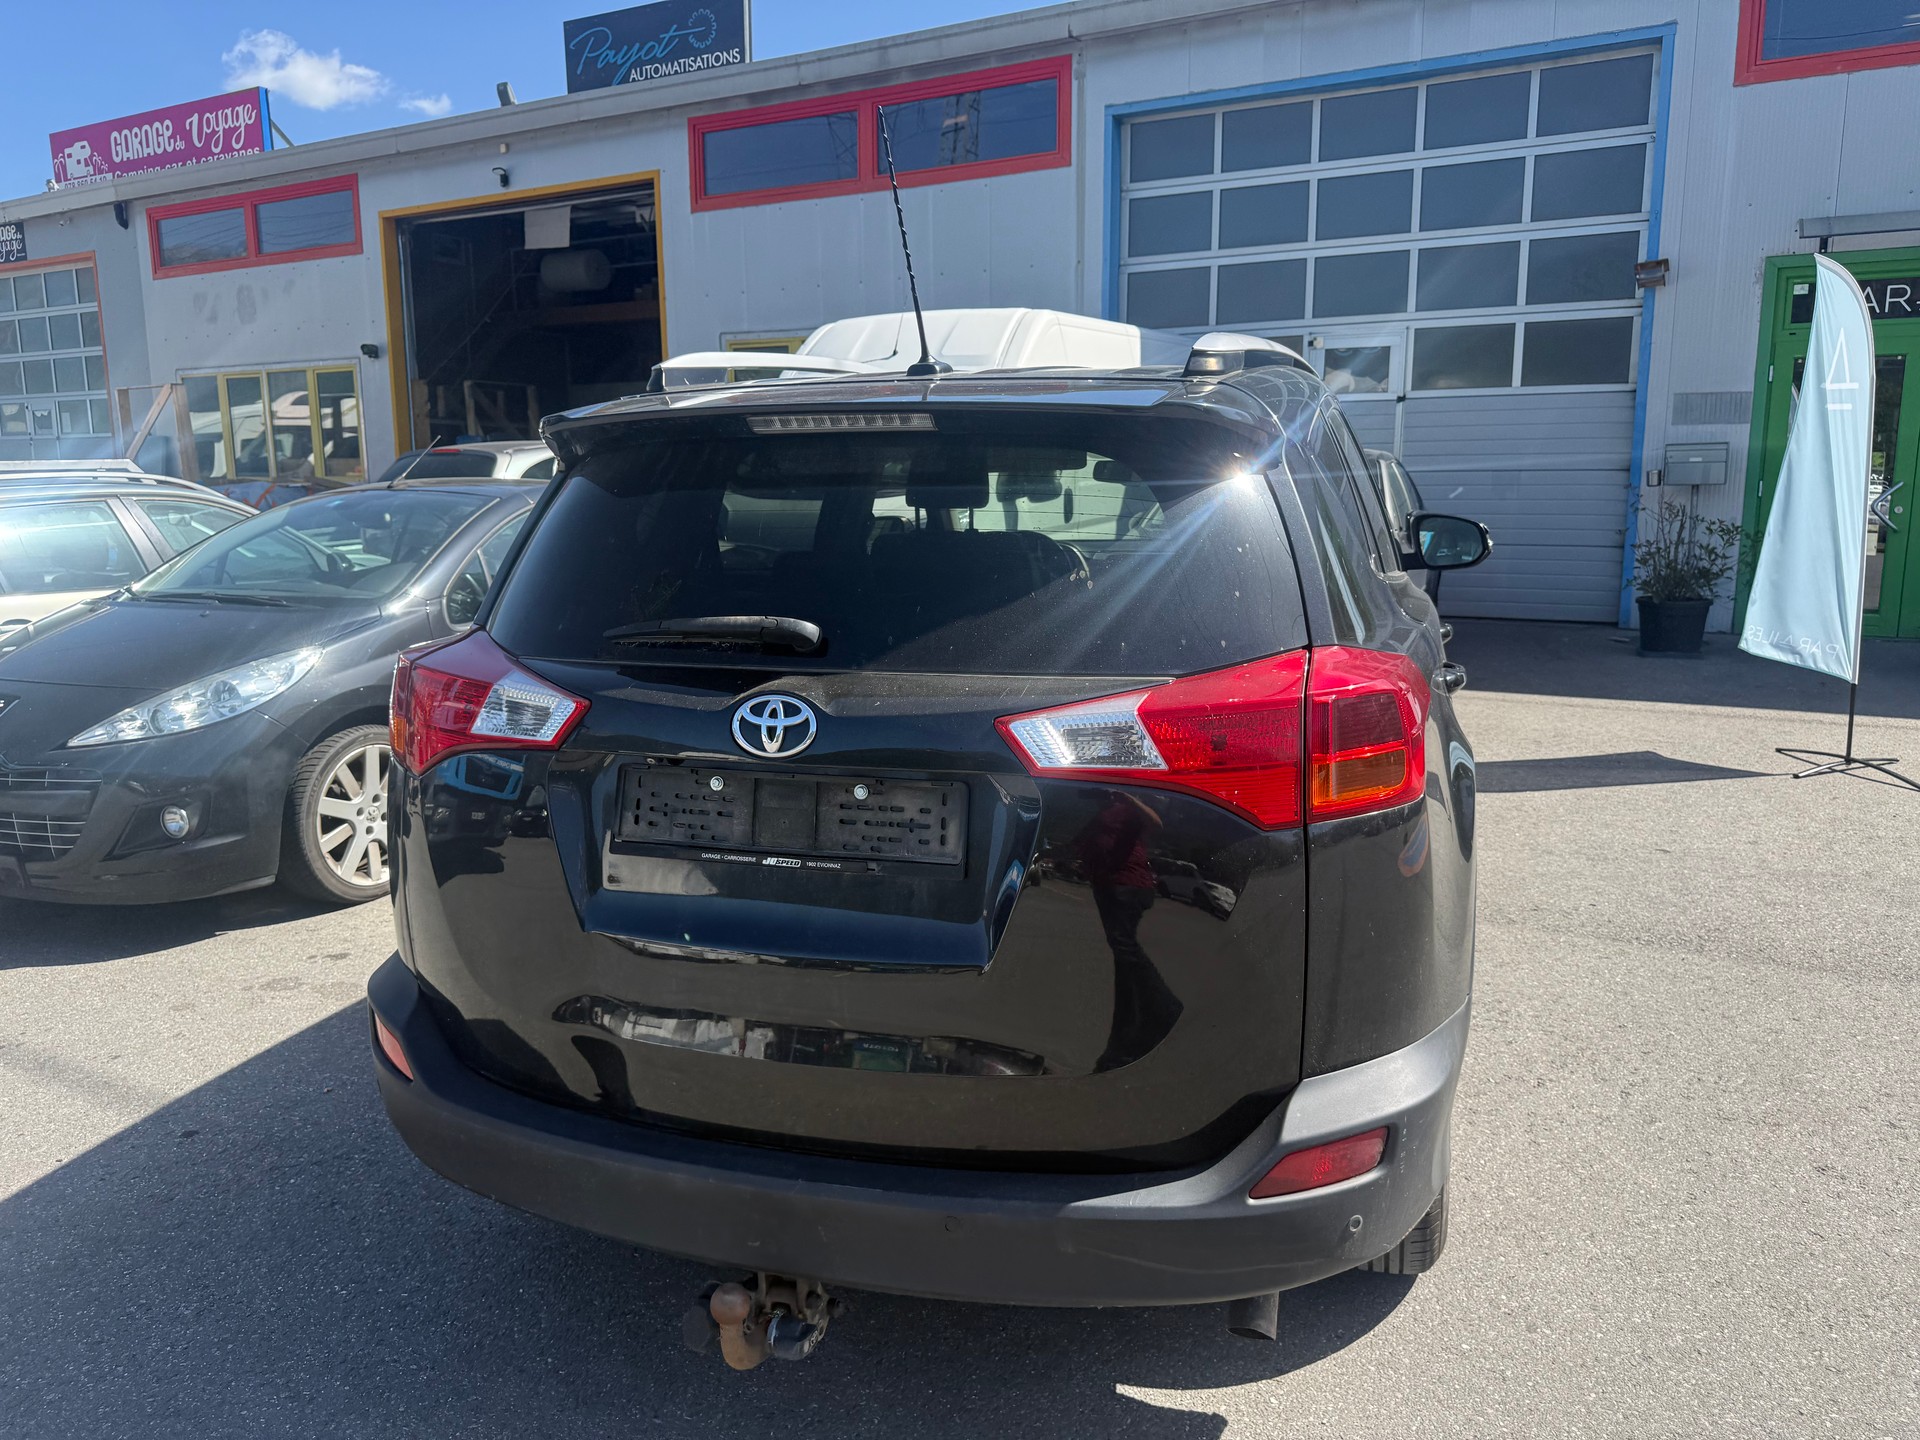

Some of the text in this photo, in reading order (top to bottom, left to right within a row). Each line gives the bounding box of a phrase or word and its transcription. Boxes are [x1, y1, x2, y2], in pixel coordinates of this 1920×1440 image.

[569, 24, 706, 86] Payot
[629, 48, 741, 83] AUTOMATISATIONS
[175, 134, 185, 151] du
[186, 103, 257, 153] Voyage
[1863, 284, 1912, 313] AR
[701, 852, 721, 860] GARAGE
